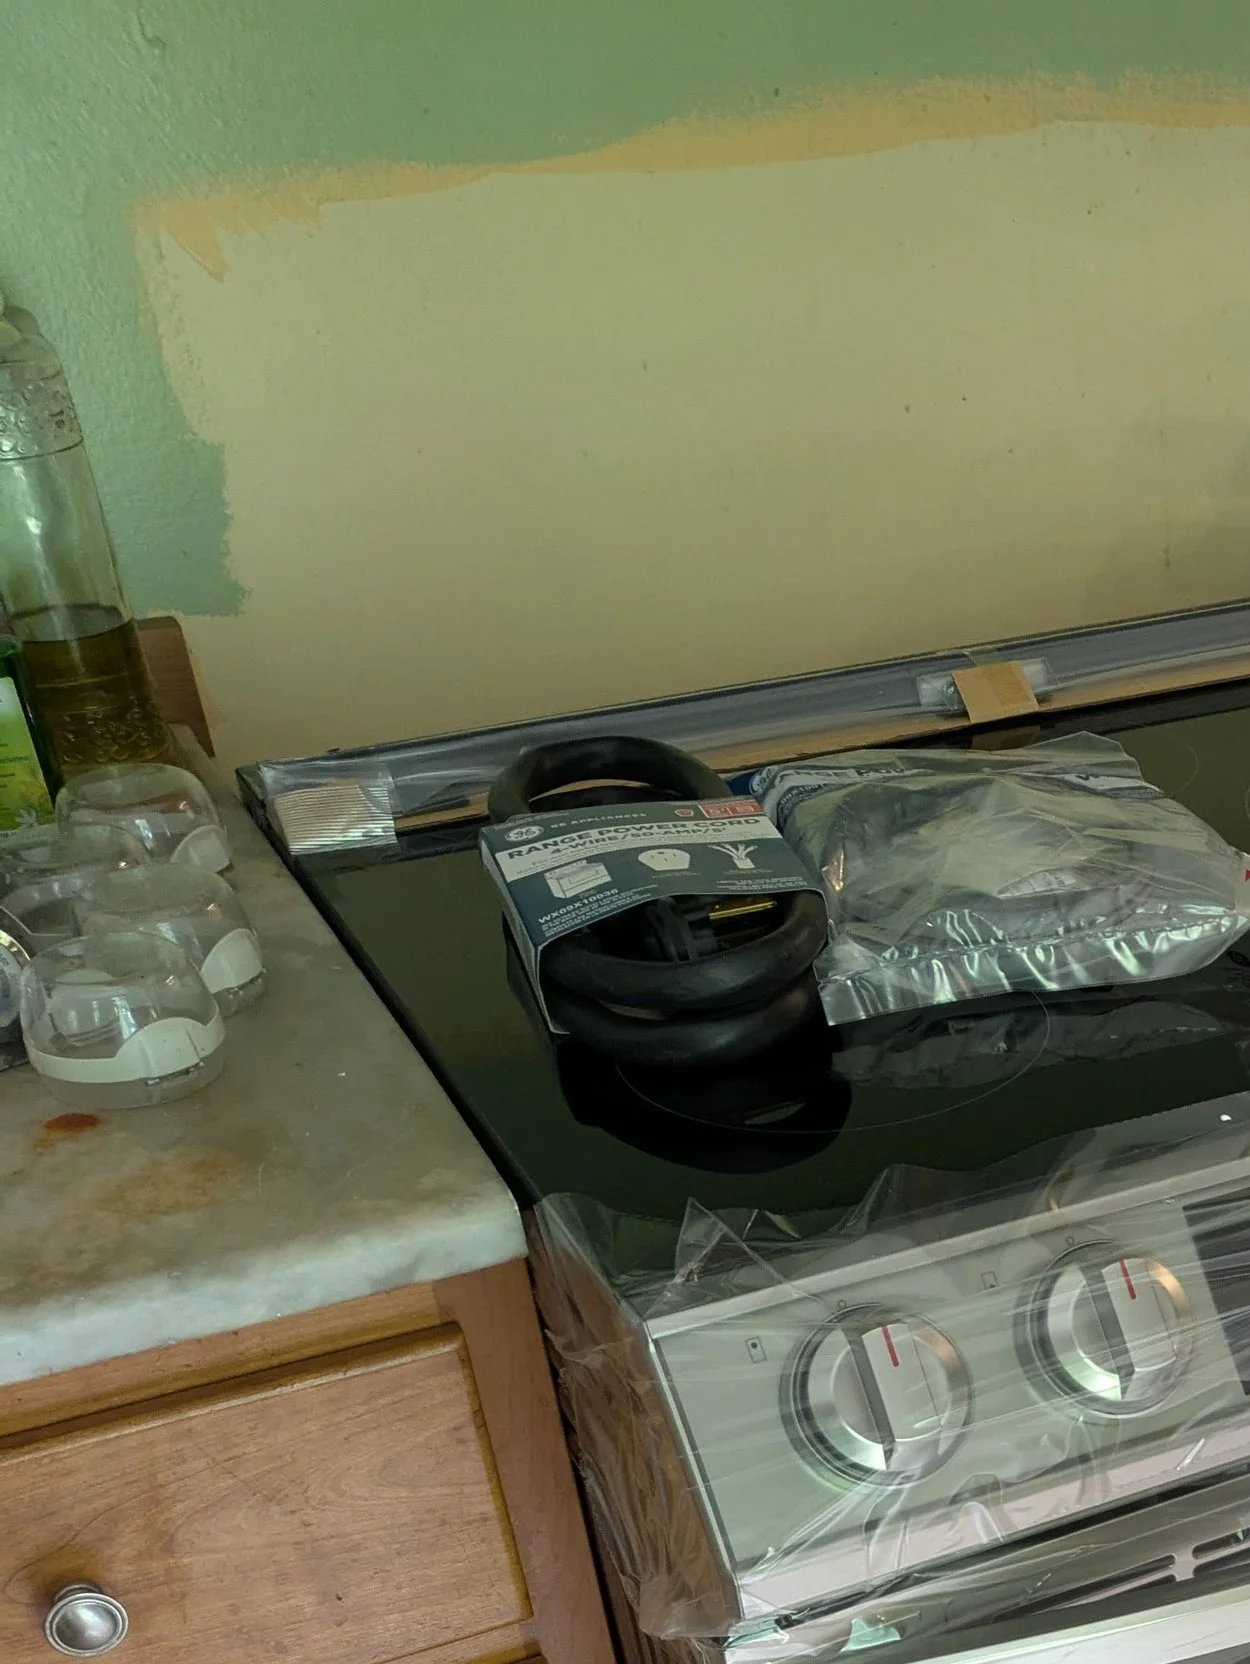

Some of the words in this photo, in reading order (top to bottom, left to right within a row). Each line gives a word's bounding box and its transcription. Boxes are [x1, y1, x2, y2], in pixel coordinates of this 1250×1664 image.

[571, 812, 648, 825] APPLIANCES
[507, 832, 593, 860] RANGE
[598, 822, 688, 836] POWER
[693, 818, 761, 829] CORD
